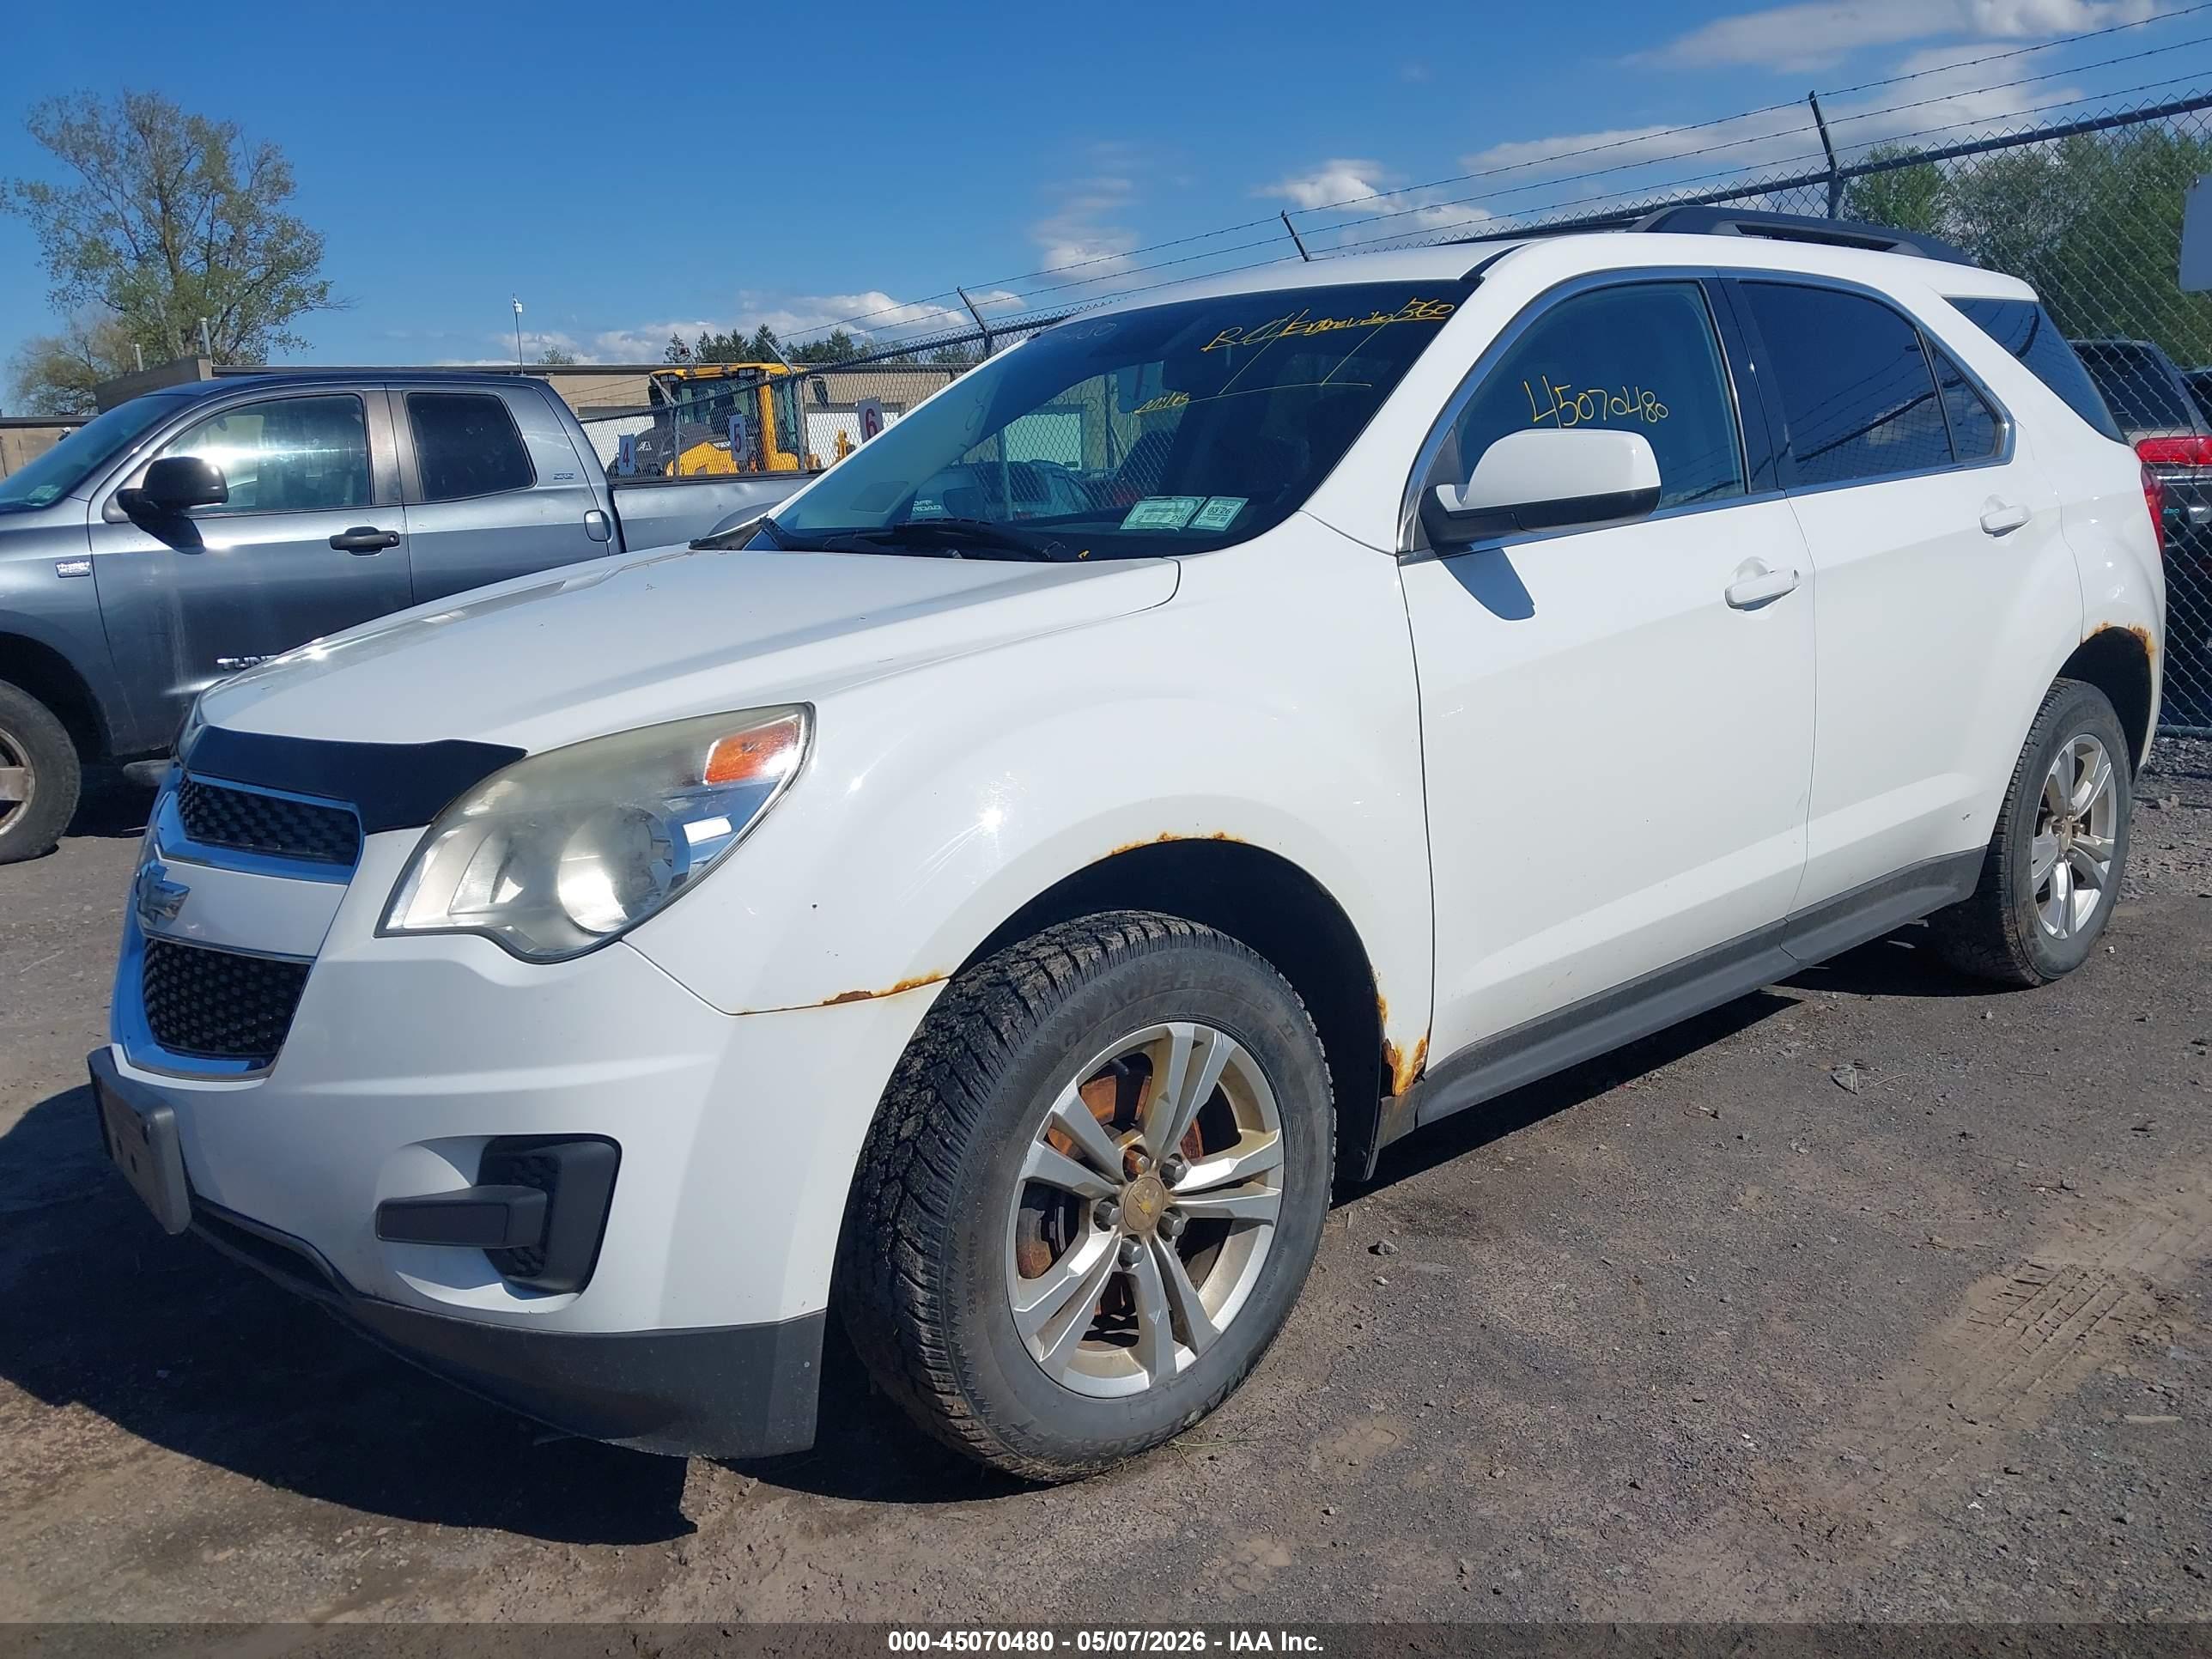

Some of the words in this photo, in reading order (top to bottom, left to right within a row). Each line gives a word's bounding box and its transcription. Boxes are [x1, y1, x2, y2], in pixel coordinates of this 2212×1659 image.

[1522, 375, 1669, 428] 45070480
[733, 423, 742, 453] 5
[865, 408, 878, 439] 6
[623, 441, 630, 468] 4
